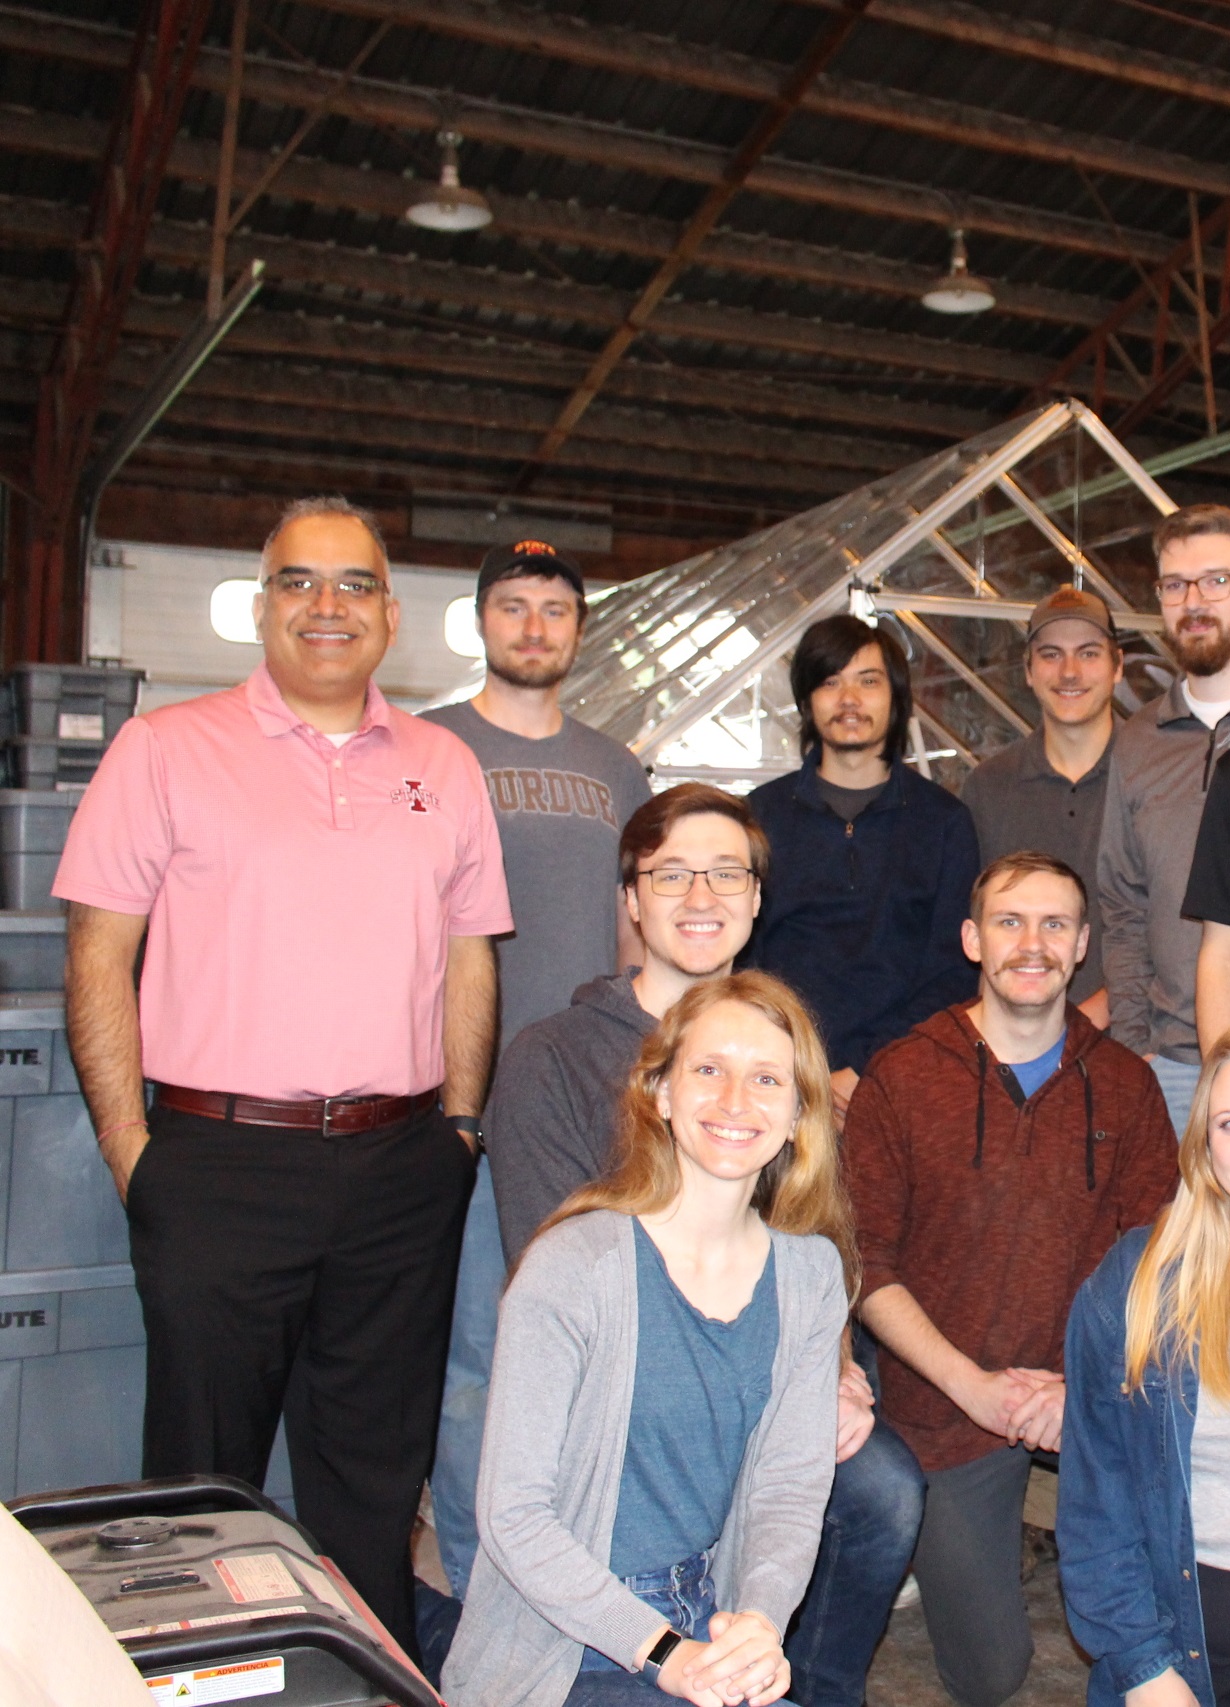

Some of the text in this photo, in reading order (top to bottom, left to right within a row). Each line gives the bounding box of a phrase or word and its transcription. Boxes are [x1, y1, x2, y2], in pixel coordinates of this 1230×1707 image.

[390, 788, 441, 809] STATE
[484, 767, 619, 832] URDUE
[216, 1661, 269, 1676] ADVERTENCIA
